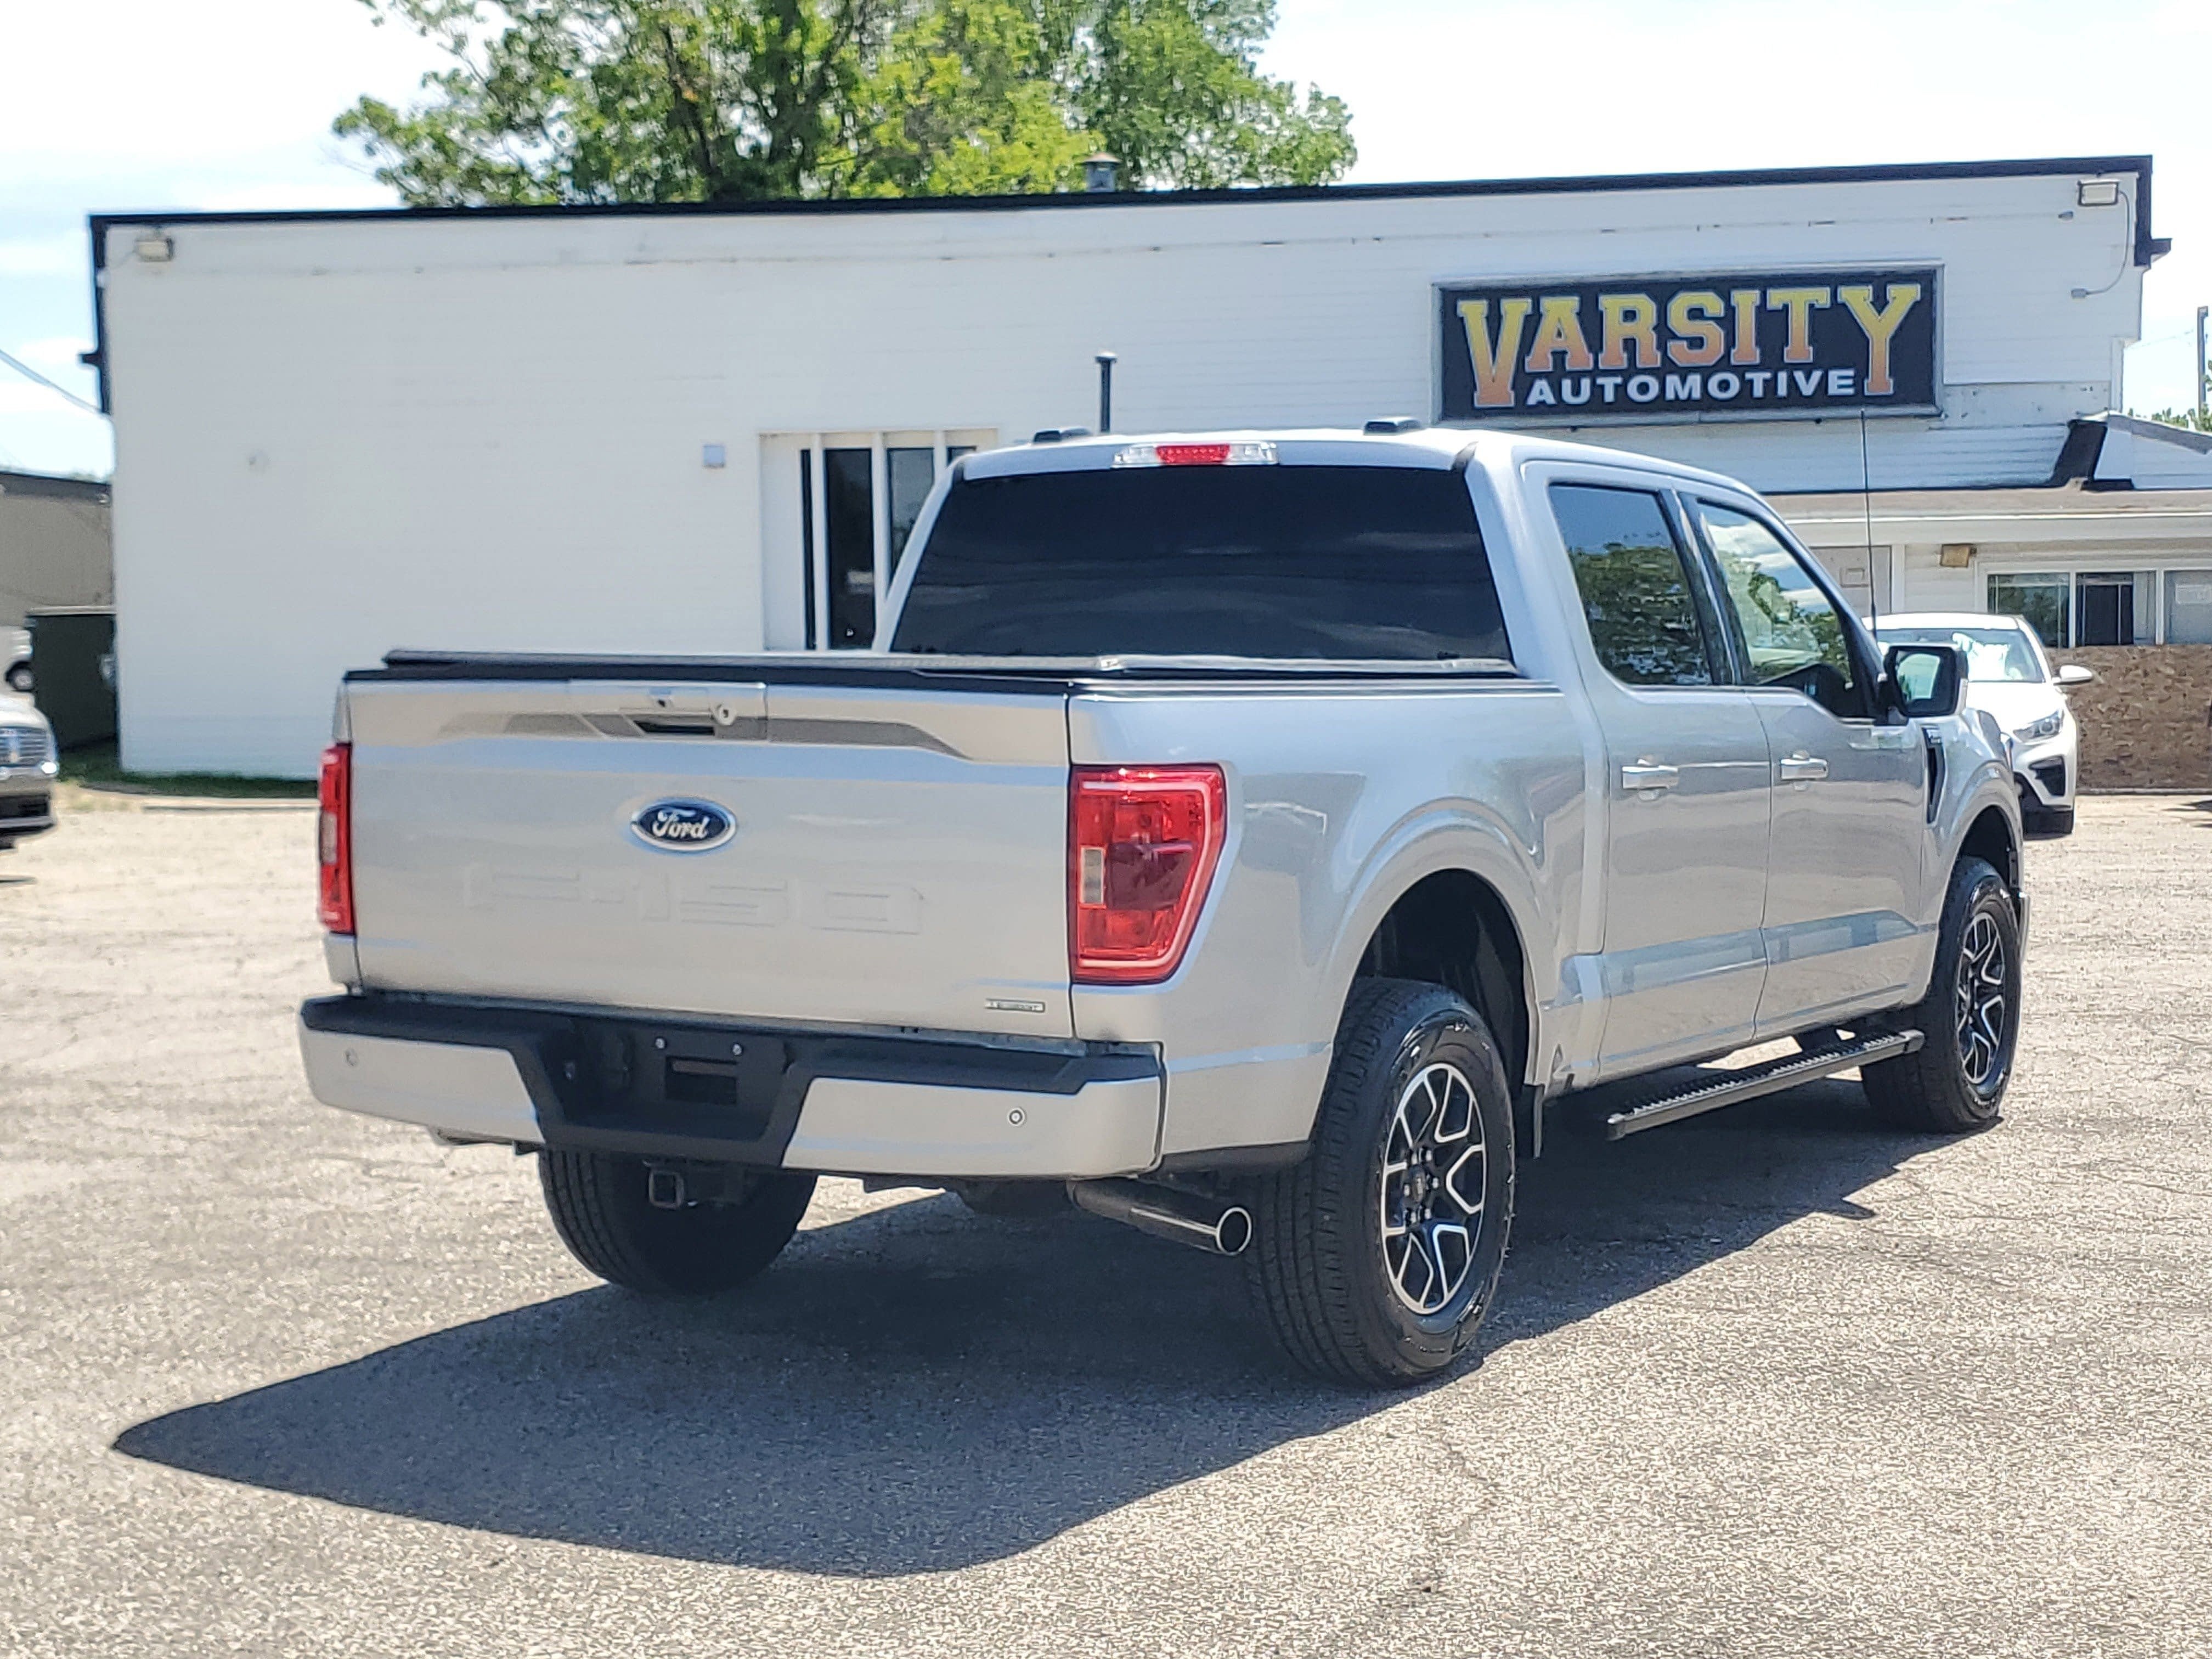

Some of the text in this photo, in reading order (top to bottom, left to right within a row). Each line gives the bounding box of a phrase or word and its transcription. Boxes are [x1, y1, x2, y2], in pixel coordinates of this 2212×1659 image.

[1457, 283, 1921, 408] VARSITY
[1526, 369, 1857, 407] AUTOMOTIVE
[652, 809, 711, 838] Ford
